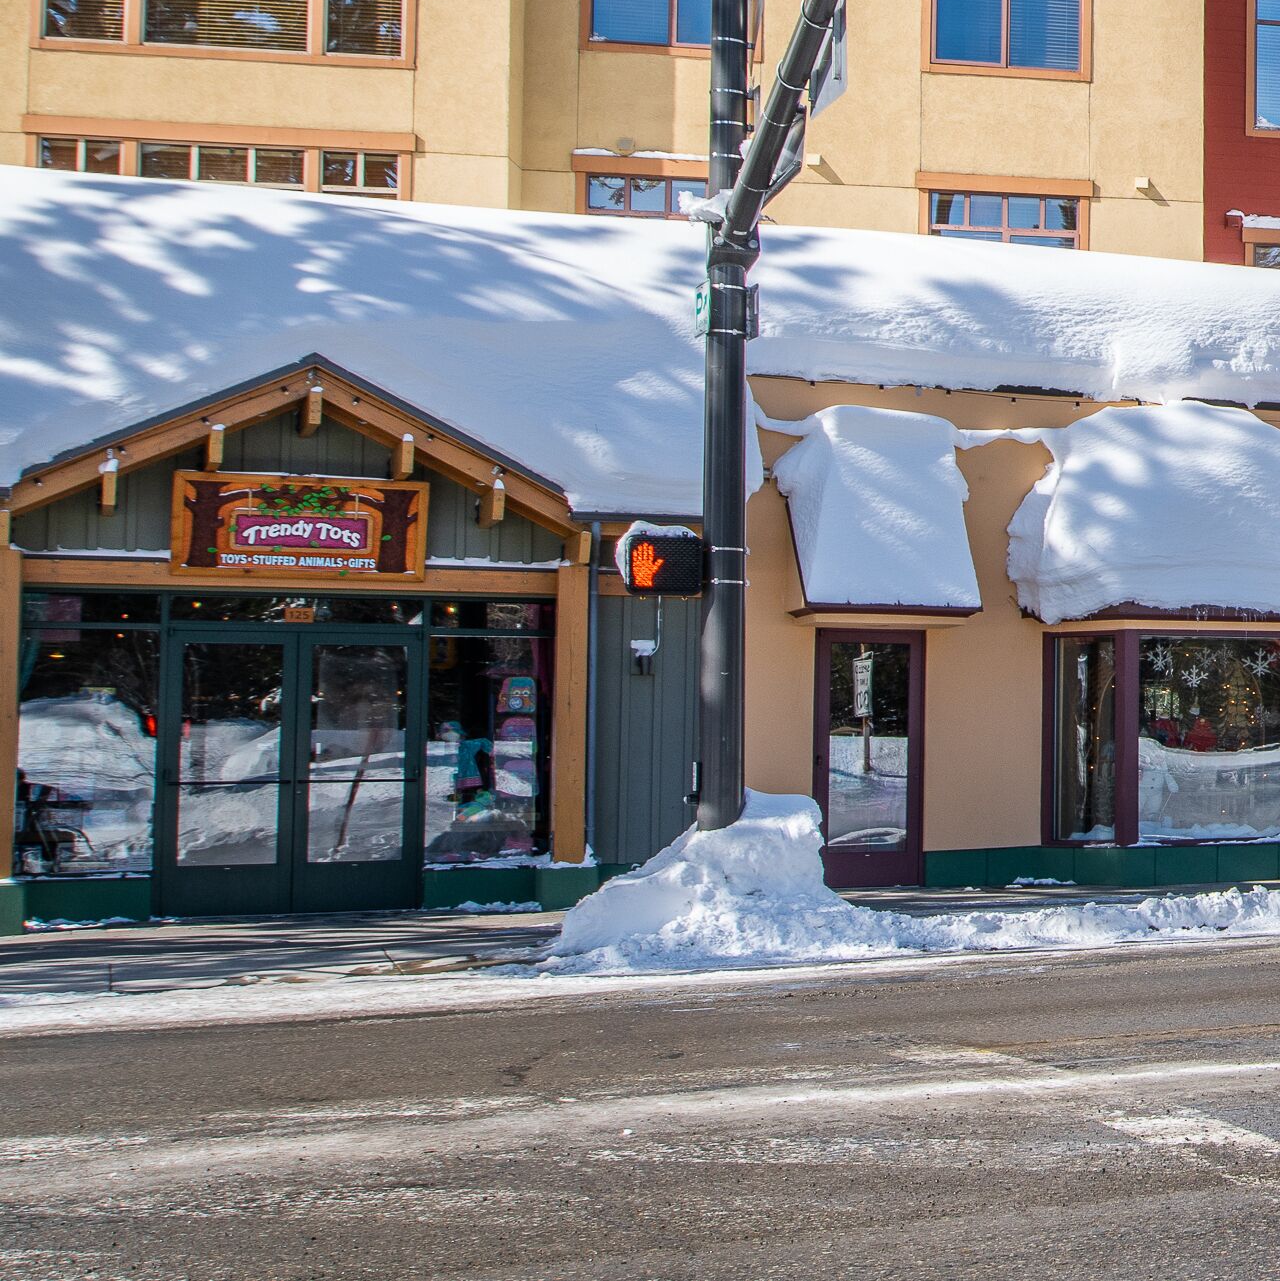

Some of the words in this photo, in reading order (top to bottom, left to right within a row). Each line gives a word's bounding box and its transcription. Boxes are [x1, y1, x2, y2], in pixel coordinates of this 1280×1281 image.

[242, 520, 313, 545] Trendy
[315, 522, 361, 547] Tots
[220, 554, 247, 564] TOYS
[252, 555, 296, 566] STUFFED
[298, 556, 343, 567] ANIMALS
[348, 558, 376, 568] GIFTS
[288, 611, 310, 620] 125
